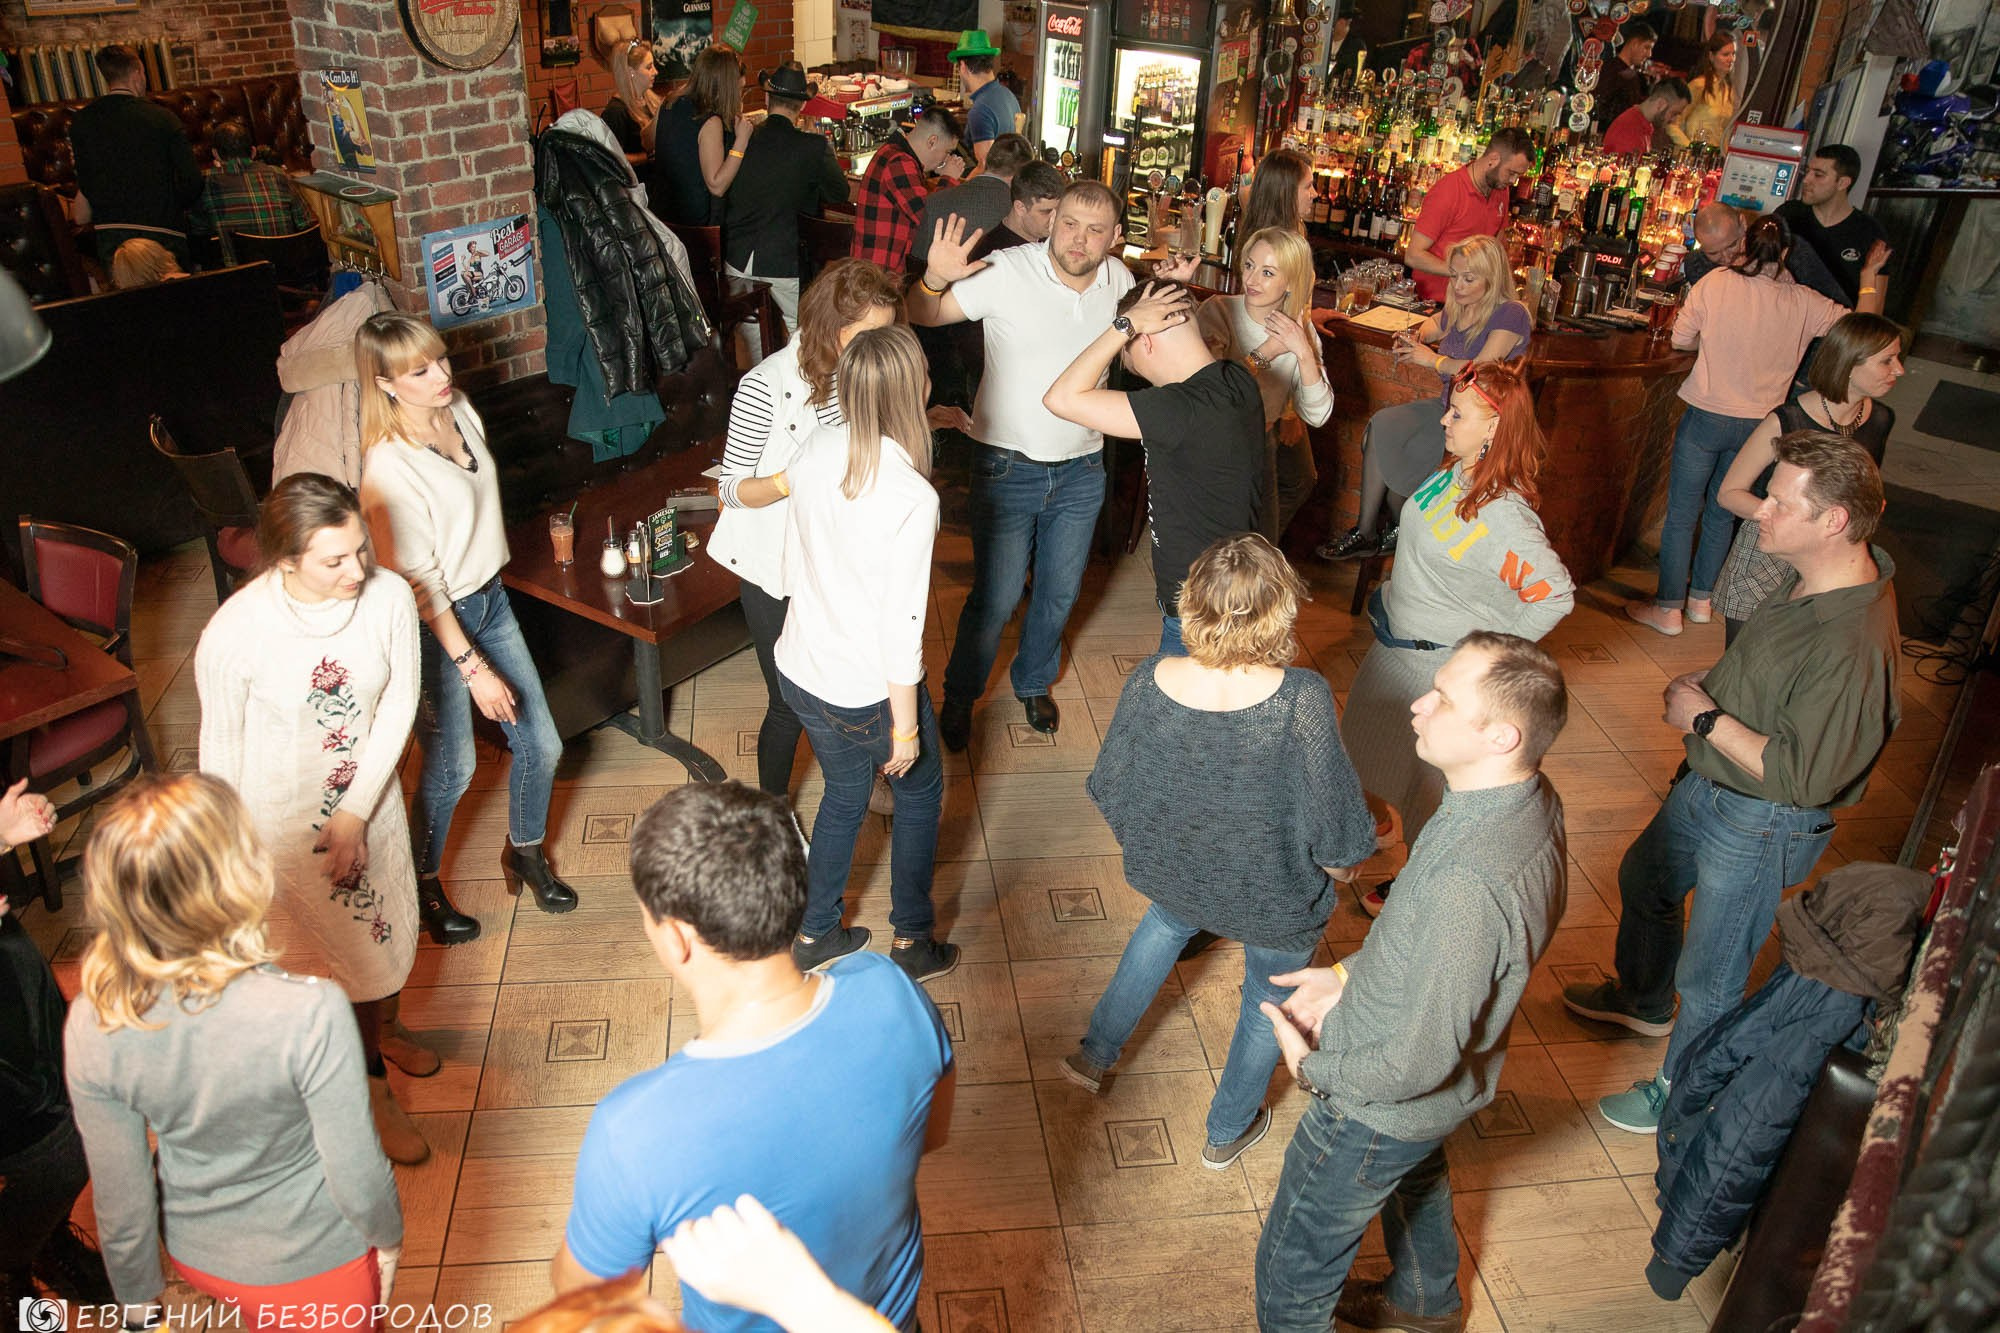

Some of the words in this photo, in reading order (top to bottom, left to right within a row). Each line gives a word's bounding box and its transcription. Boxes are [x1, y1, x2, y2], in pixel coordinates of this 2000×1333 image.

[683, 2, 710, 13] GUINNESS
[1047, 13, 1083, 36] Coca-Cola
[330, 70, 342, 84] Can
[341, 70, 351, 83] Do
[490, 220, 516, 245] Best
[500, 230, 525, 252] GARAGE
